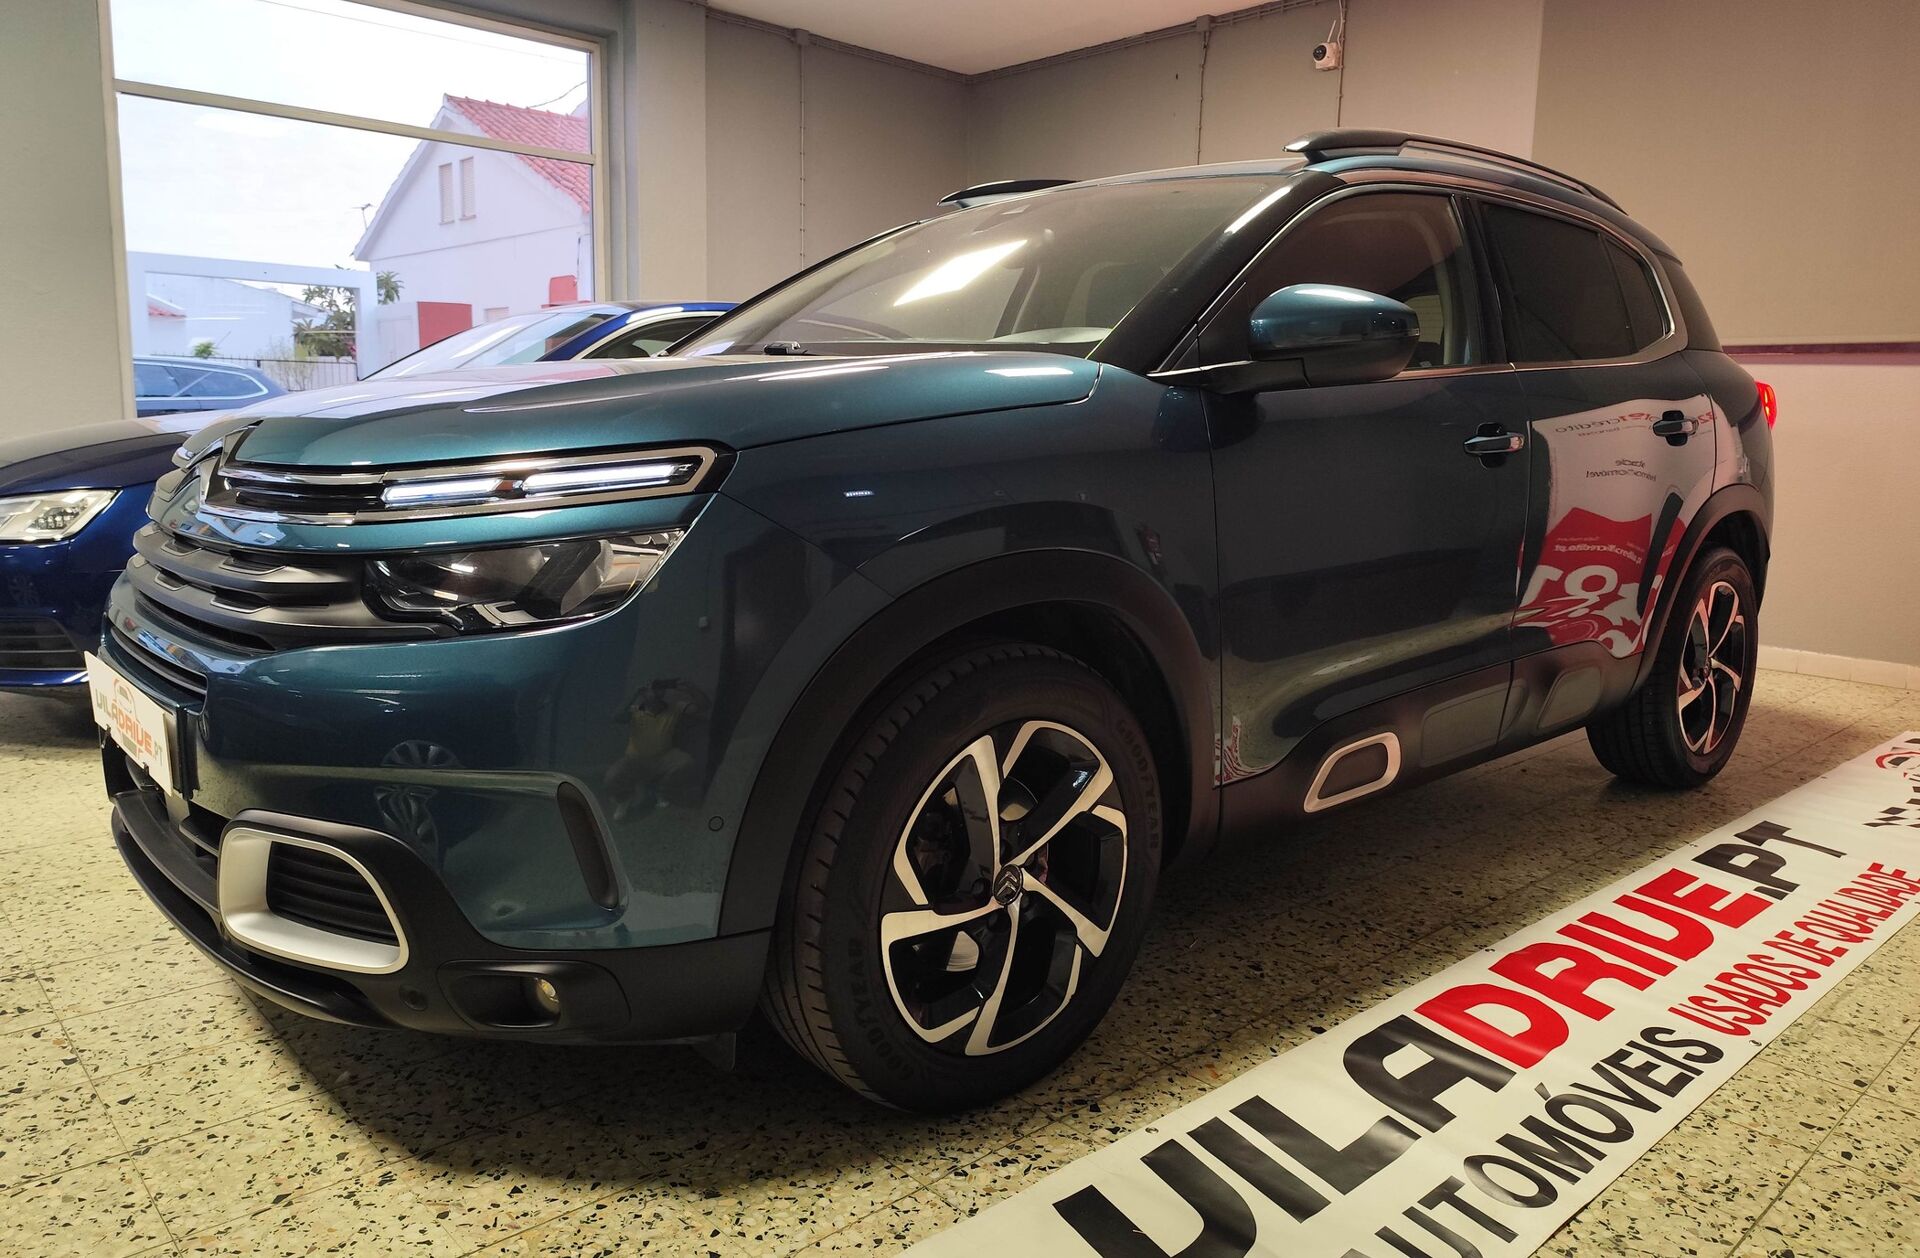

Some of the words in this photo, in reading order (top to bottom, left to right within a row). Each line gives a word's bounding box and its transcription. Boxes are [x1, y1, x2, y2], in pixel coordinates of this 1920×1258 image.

[1793, 862, 1920, 944] QUALIDADE
[1761, 929, 1850, 968] DE
[1667, 954, 1822, 1037] USADOS
[1340, 1026, 1725, 1258] UTOMÓVEIS
